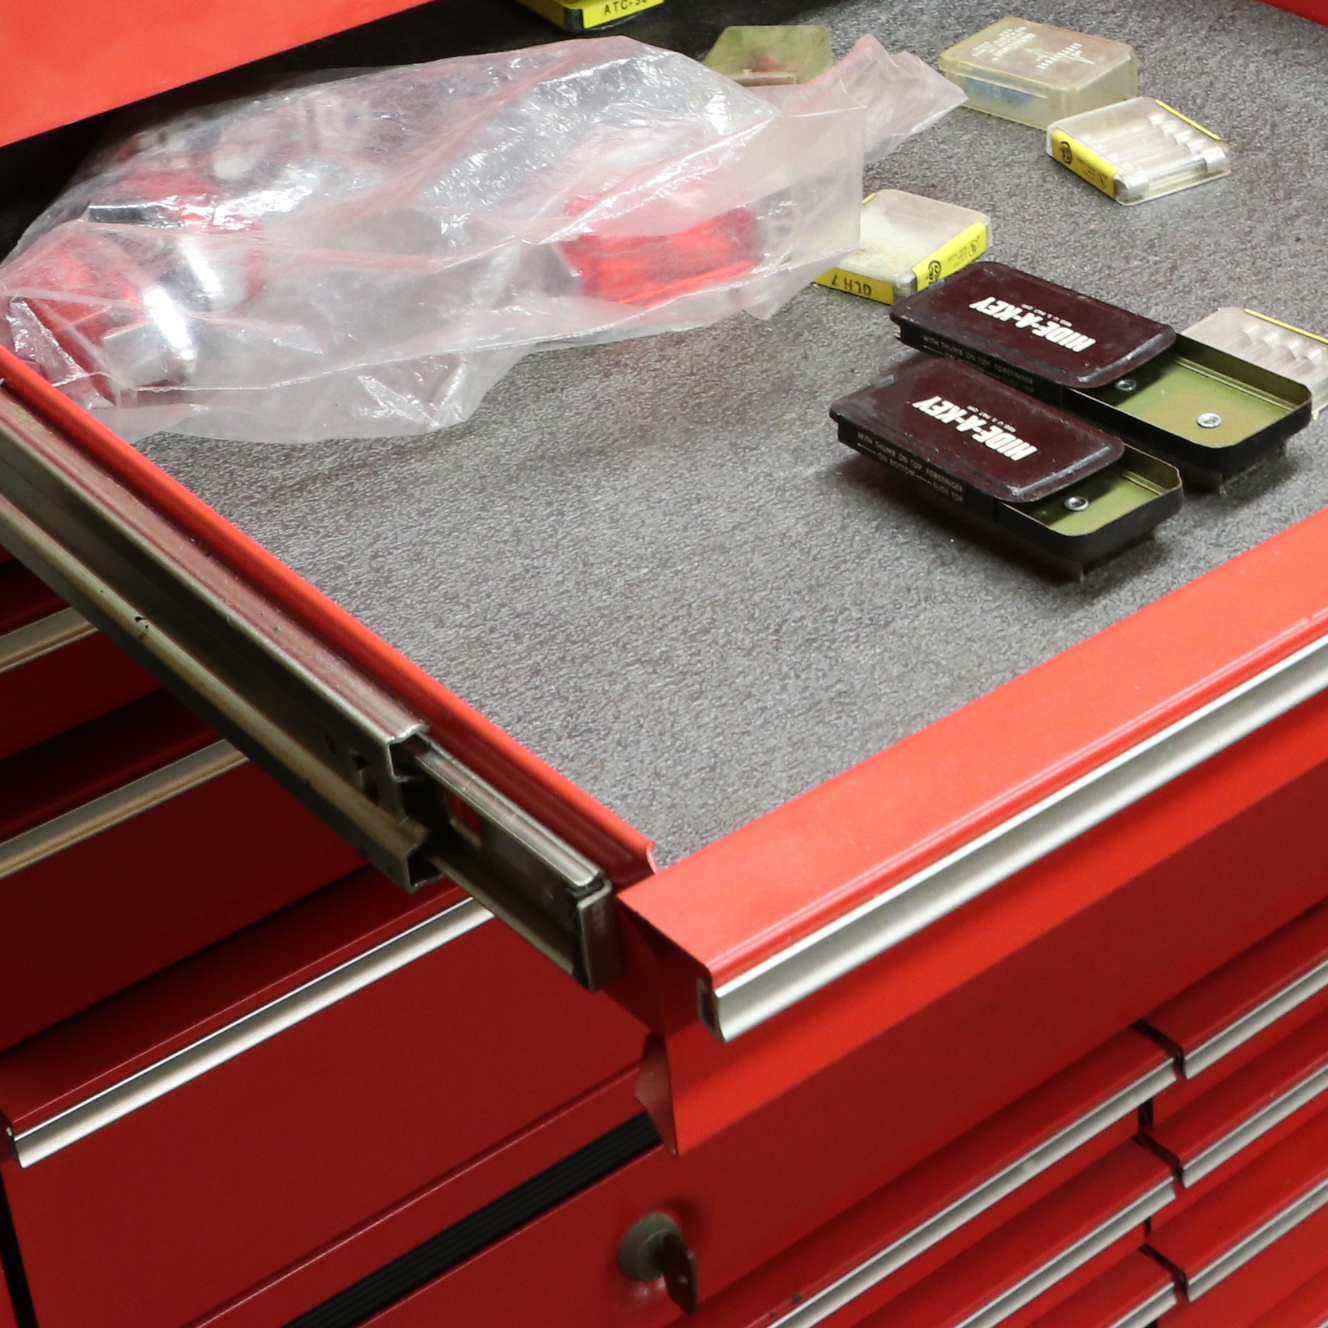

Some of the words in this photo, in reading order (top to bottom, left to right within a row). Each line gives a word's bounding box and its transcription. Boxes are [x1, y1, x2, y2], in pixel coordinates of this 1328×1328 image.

[831, 274, 838, 285] 7
[969, 296, 1097, 353] HIDE-A-KEY
[912, 395, 1038, 462] HIDE-A-KEY
